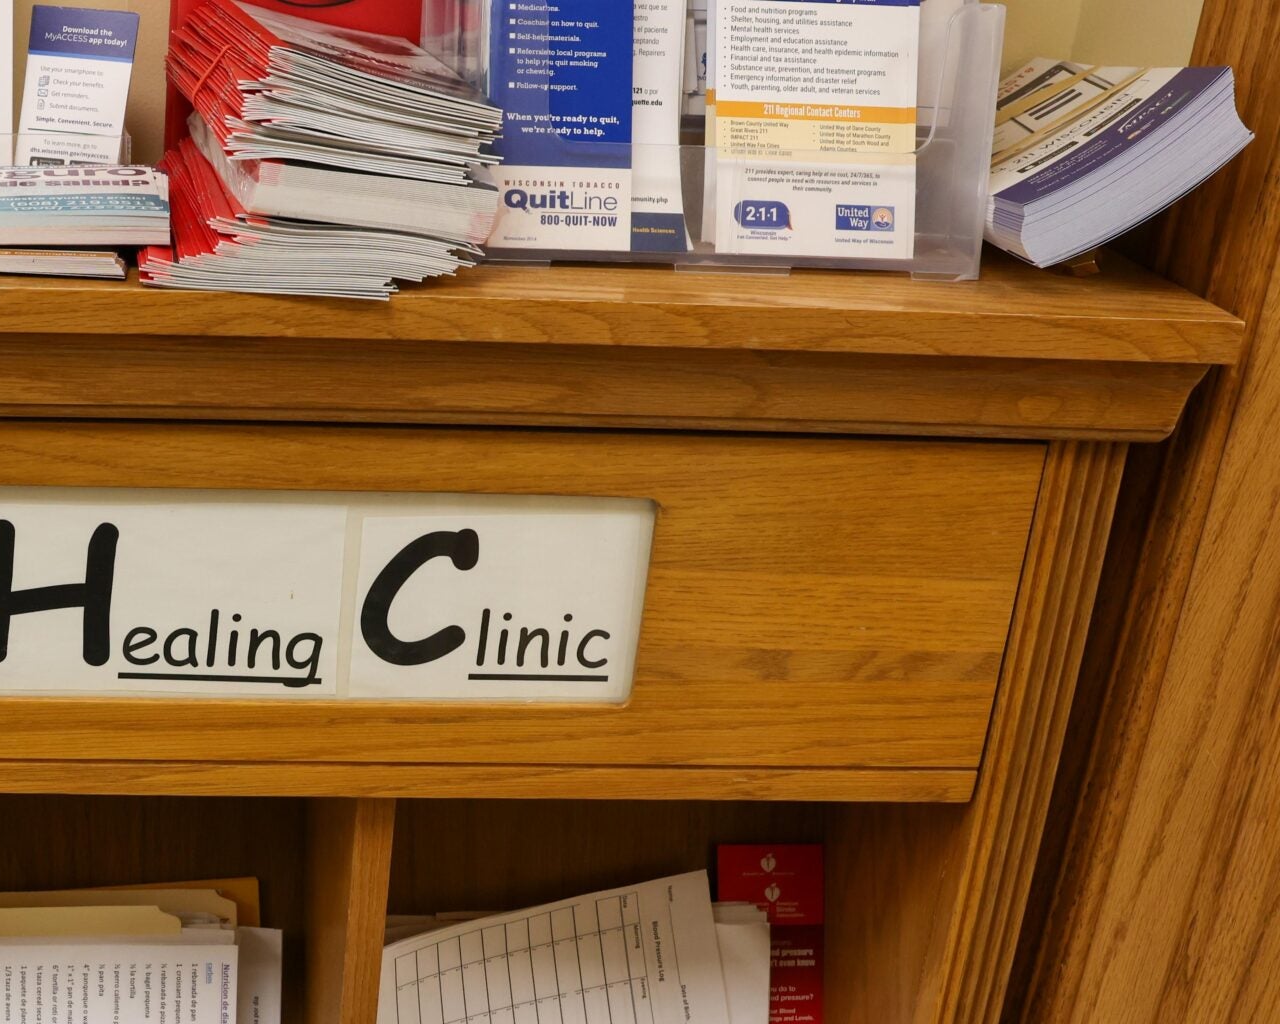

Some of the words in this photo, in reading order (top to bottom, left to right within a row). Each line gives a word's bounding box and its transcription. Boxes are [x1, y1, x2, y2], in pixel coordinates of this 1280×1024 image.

[730, 5, 746, 17] Food
[747, 6, 759, 17] and
[63, 26, 98, 36] Download
[100, 28, 112, 36] the
[730, 25, 752, 34] Mental
[753, 25, 772, 33] health
[44, 32, 88, 43] MyACCESS
[104, 38, 127, 47] today!
[764, 104, 774, 116] 211
[776, 105, 805, 117] Regional
[806, 106, 834, 118] Contact
[834, 107, 860, 118] Centers
[506, 112, 531, 120] When
[534, 114, 560, 123] you're
[561, 114, 587, 124] ready
[599, 115, 619, 124] quit,
[521, 125, 545, 133] we're
[546, 126, 571, 135] ready
[572, 127, 581, 135] to
[583, 127, 605, 136] help.
[504, 190, 618, 212] QuitLine
[838, 207, 869, 218] United
[540, 214, 616, 226] 800-QUIT-NOW
[850, 218, 868, 228] Way
[360, 528, 611, 669] Clinic
[652, 921, 660, 940] Blood
[656, 940, 664, 968] Pressure
[222, 1001, 230, 1010] de
